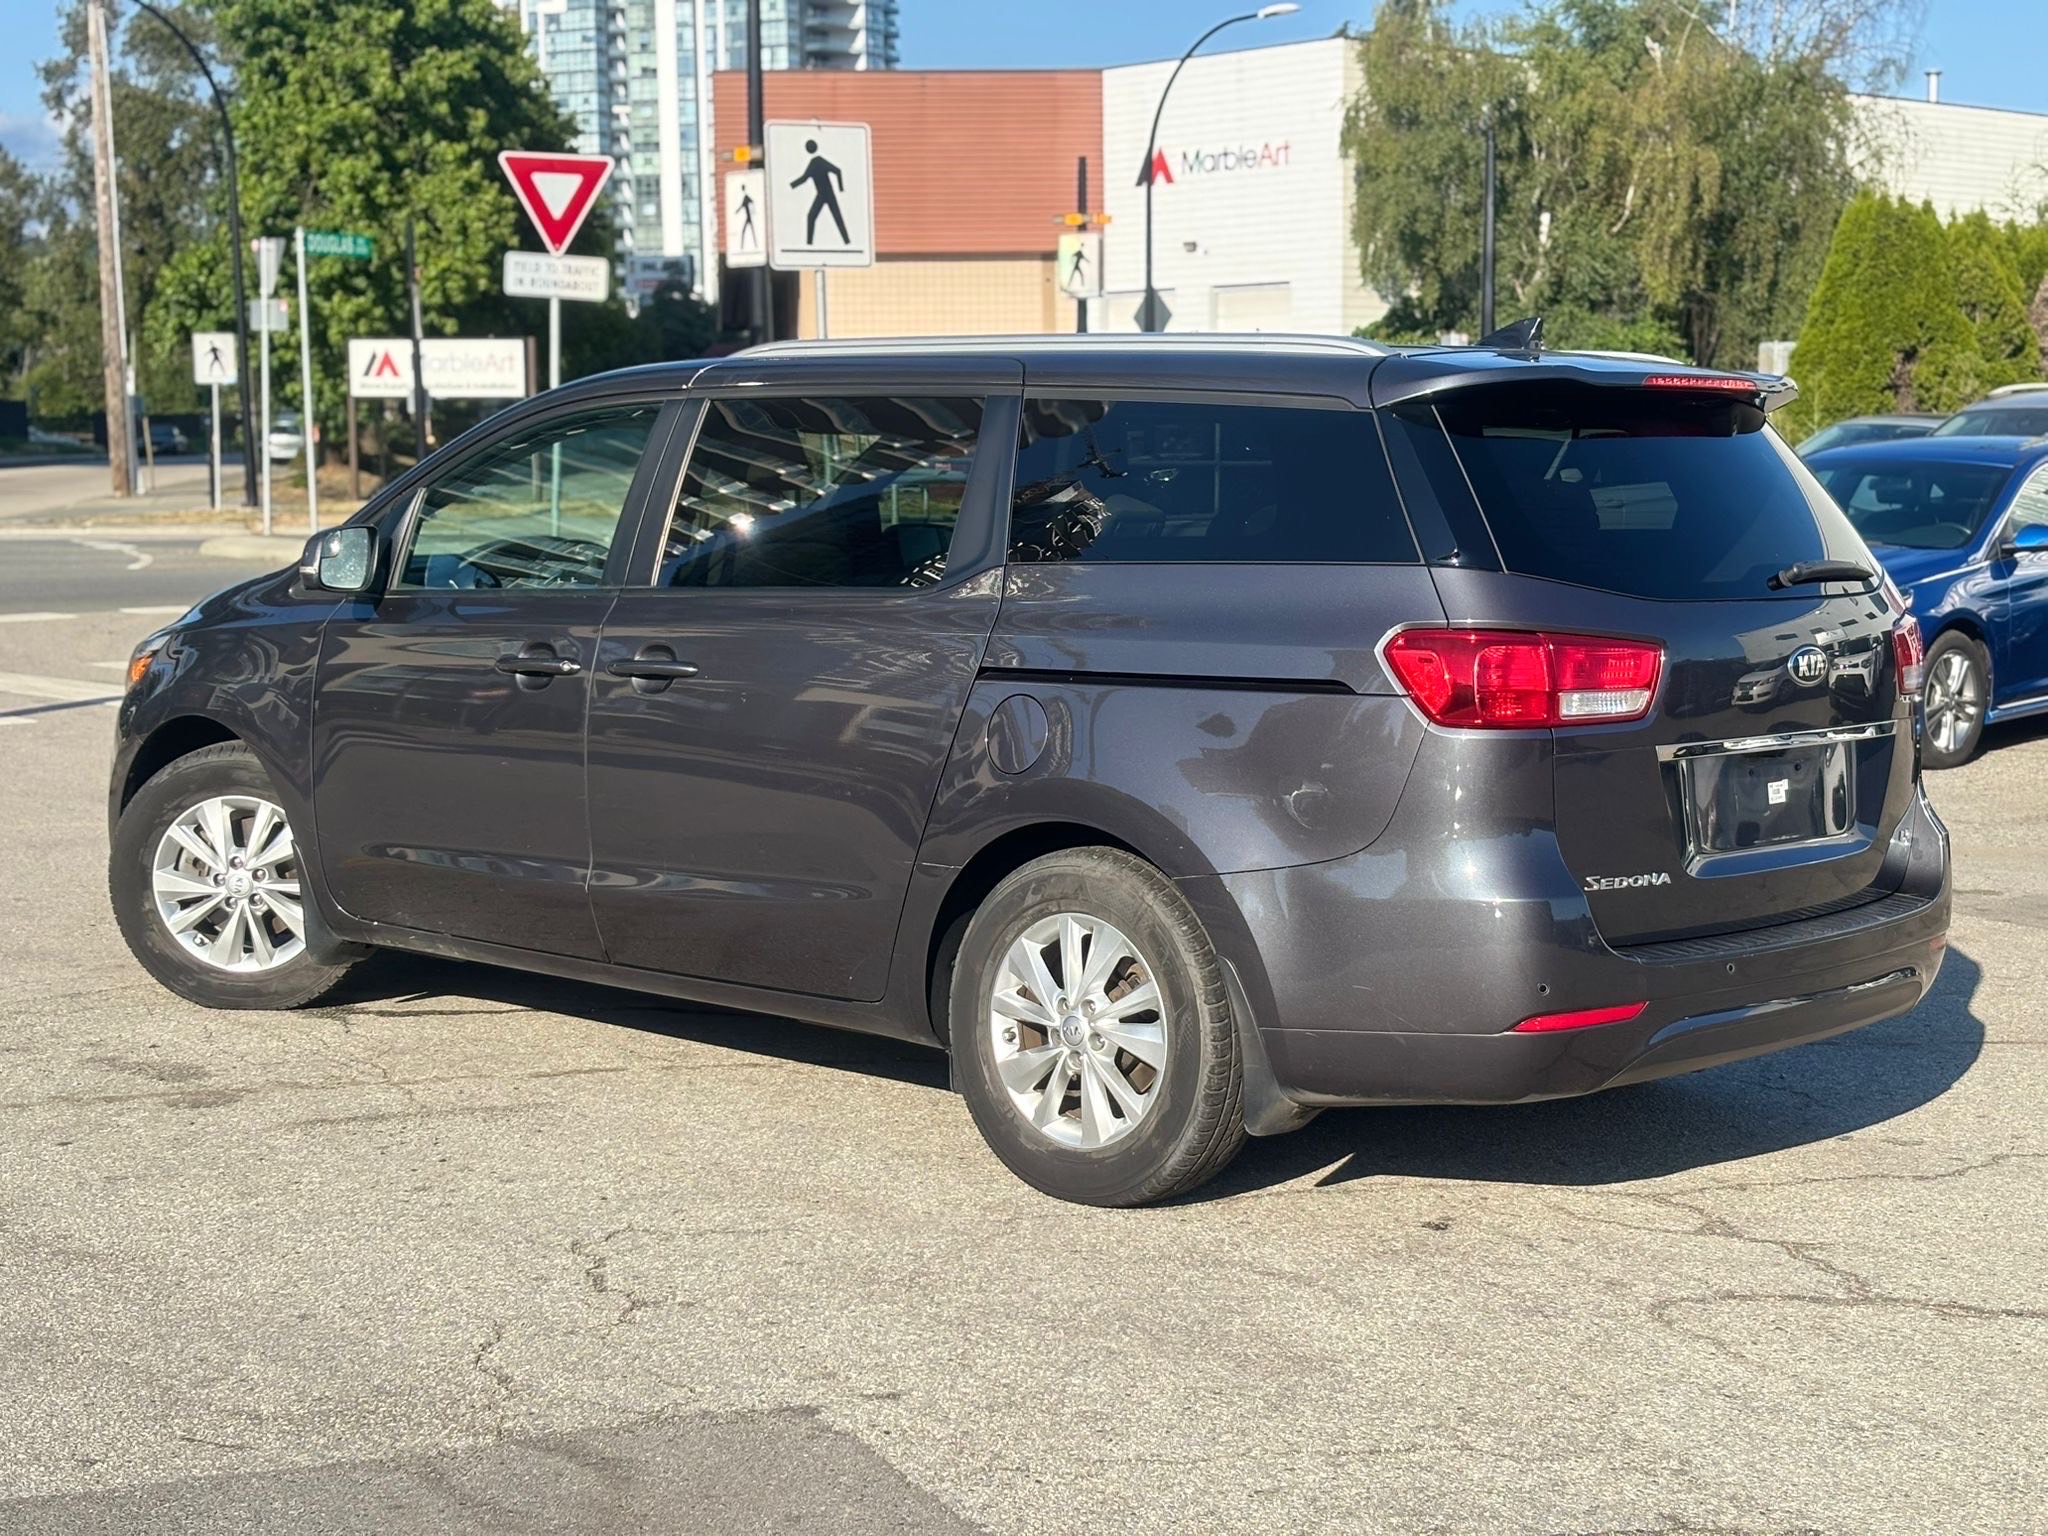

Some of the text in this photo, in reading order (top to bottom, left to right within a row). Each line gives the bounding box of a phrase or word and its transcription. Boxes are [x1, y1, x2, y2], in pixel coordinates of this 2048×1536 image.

[1182, 140, 1290, 174] MarbleArt
[1797, 654, 1825, 677] KIA
[1583, 872, 1672, 892] SEDONA
